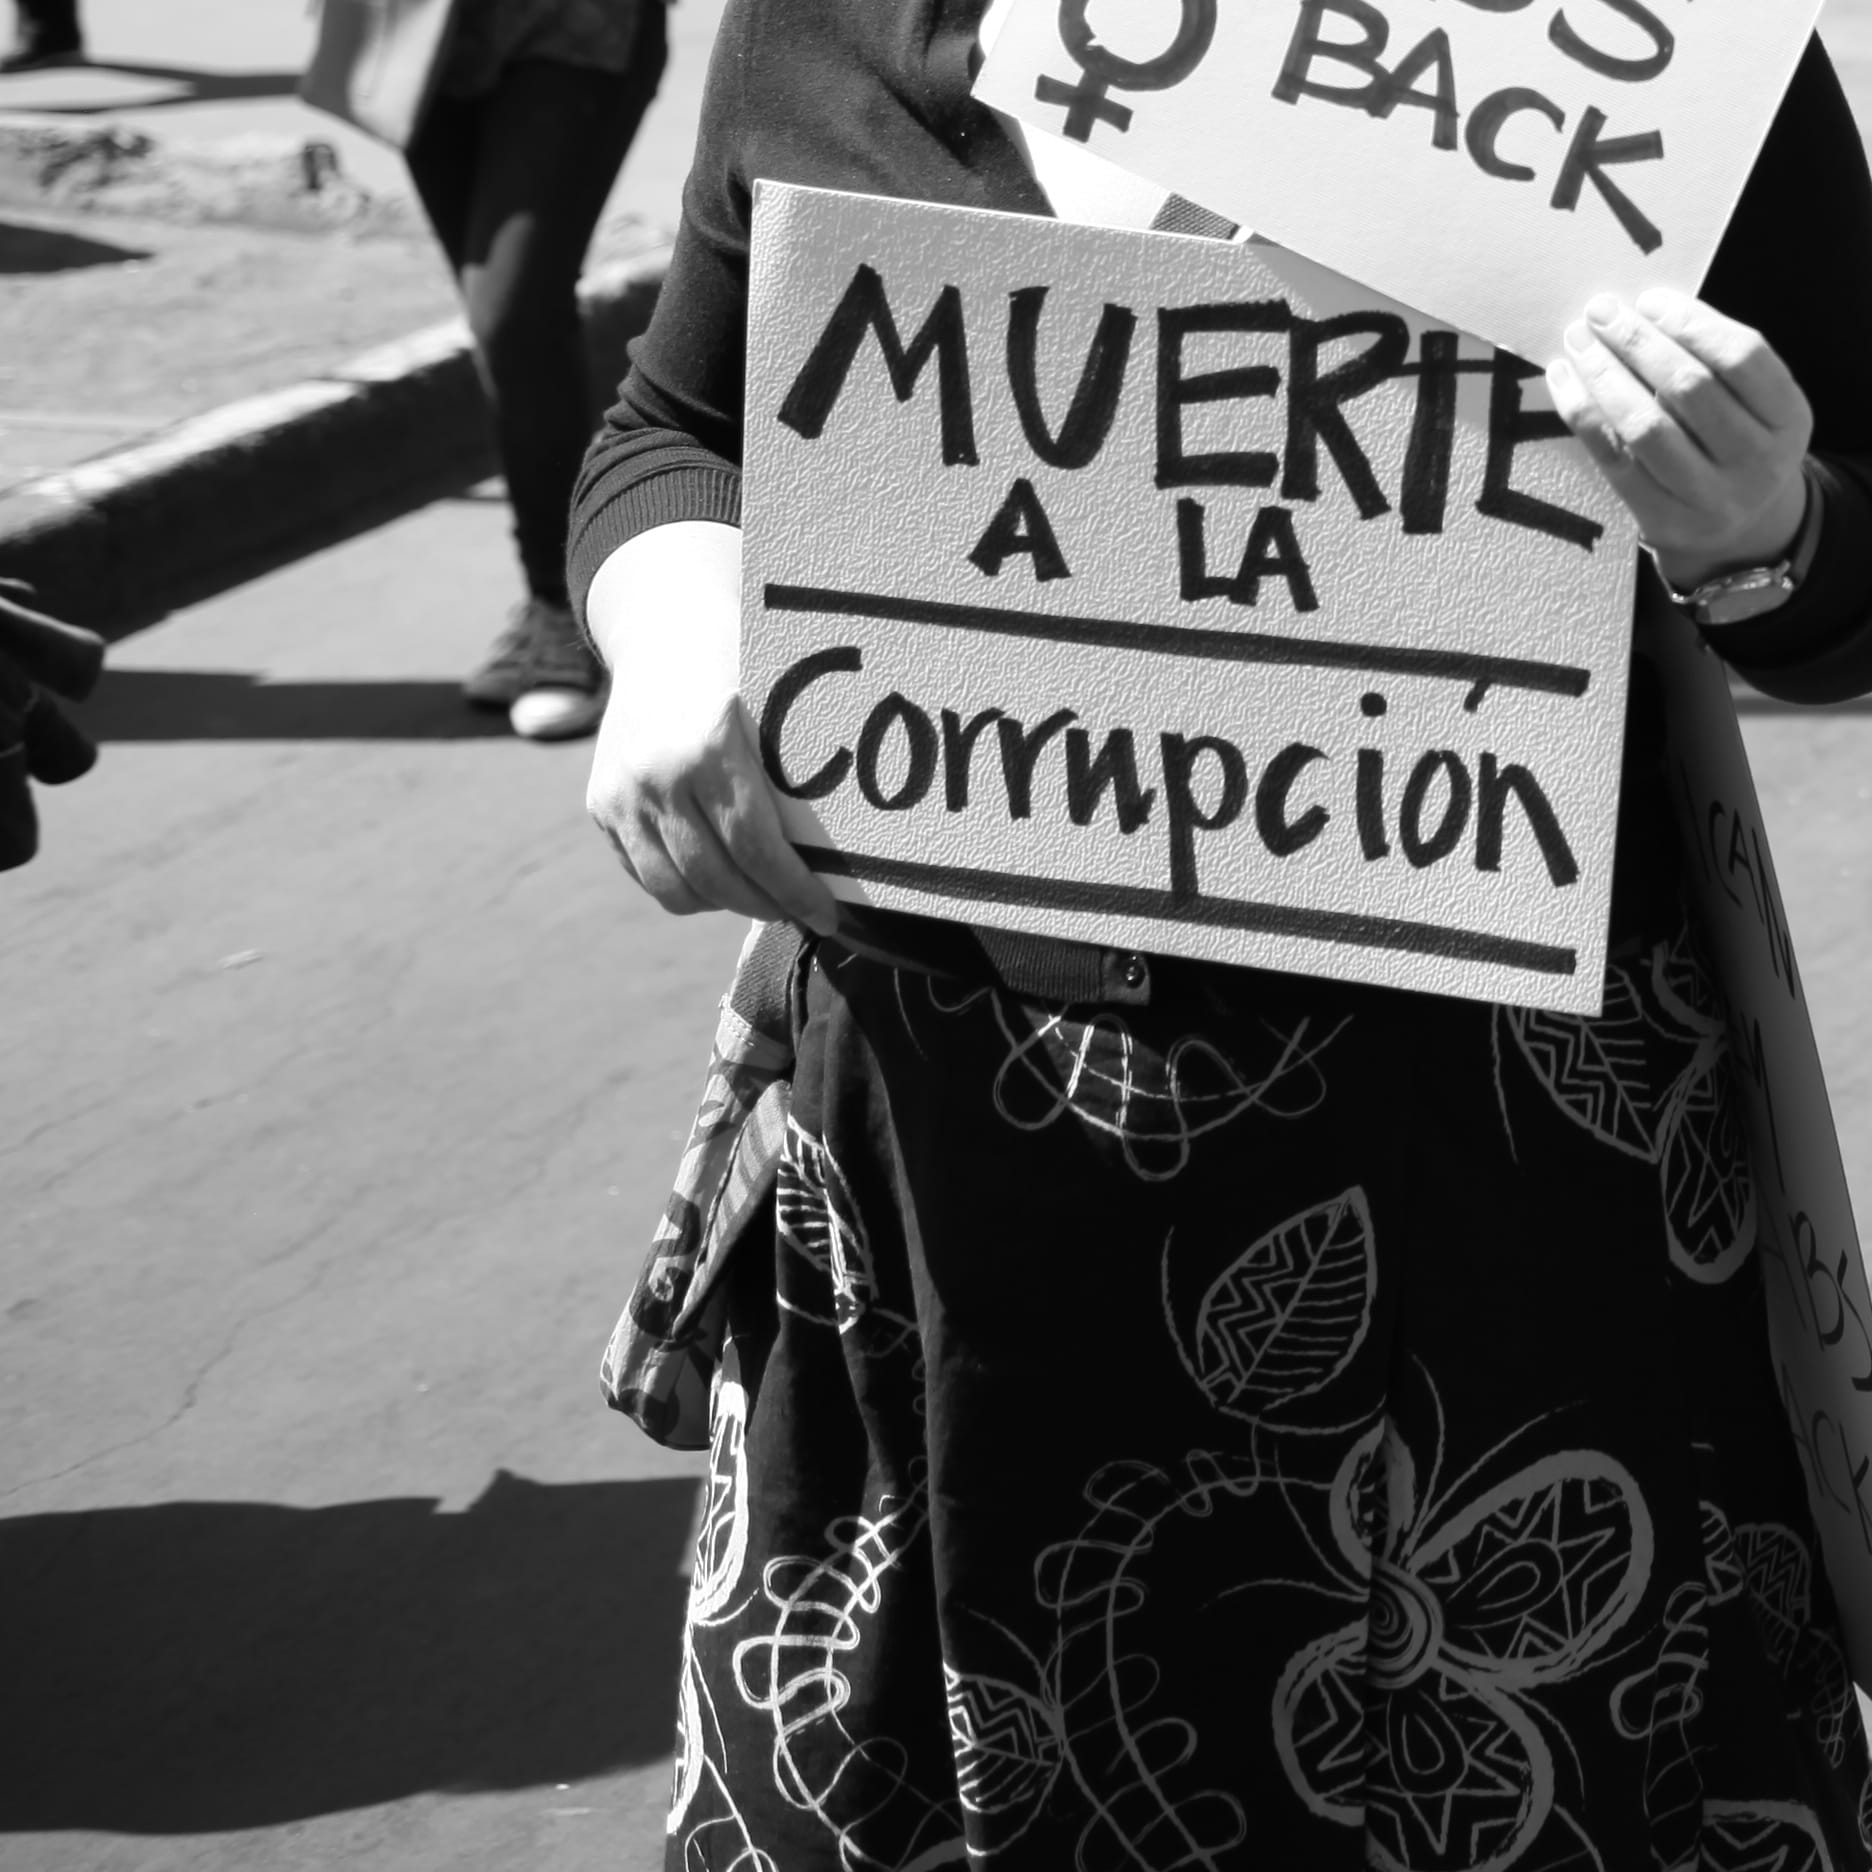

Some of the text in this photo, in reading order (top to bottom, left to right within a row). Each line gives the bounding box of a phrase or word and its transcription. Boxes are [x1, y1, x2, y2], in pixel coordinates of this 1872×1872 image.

[777, 263, 1604, 553] MUERTE
[967, 478, 1320, 614] A LA
[760, 645, 1581, 903] Corrupción
